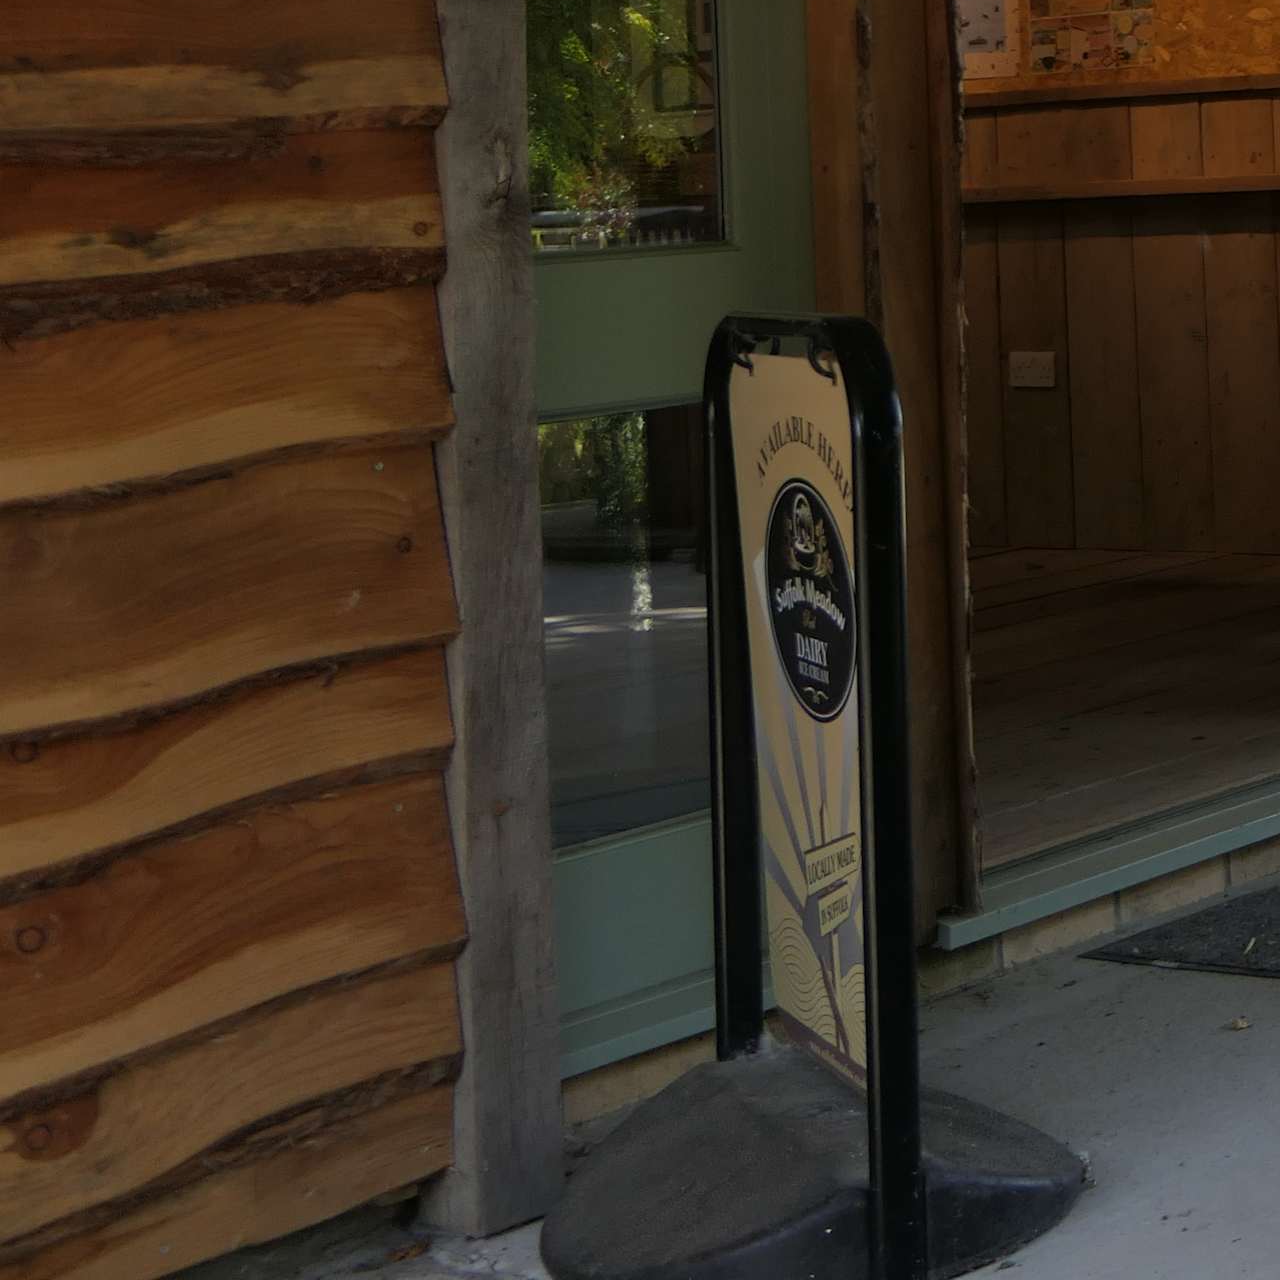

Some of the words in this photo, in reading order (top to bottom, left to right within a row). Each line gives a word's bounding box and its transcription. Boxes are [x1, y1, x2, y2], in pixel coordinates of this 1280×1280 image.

[757, 416, 815, 486] AVAILABLE
[776, 577, 806, 612] Suffolk
[805, 578, 846, 630] Meadow
[795, 632, 828, 666] DAIRY
[808, 854, 836, 884] LOCALLY
[836, 845, 857, 870] MADE
